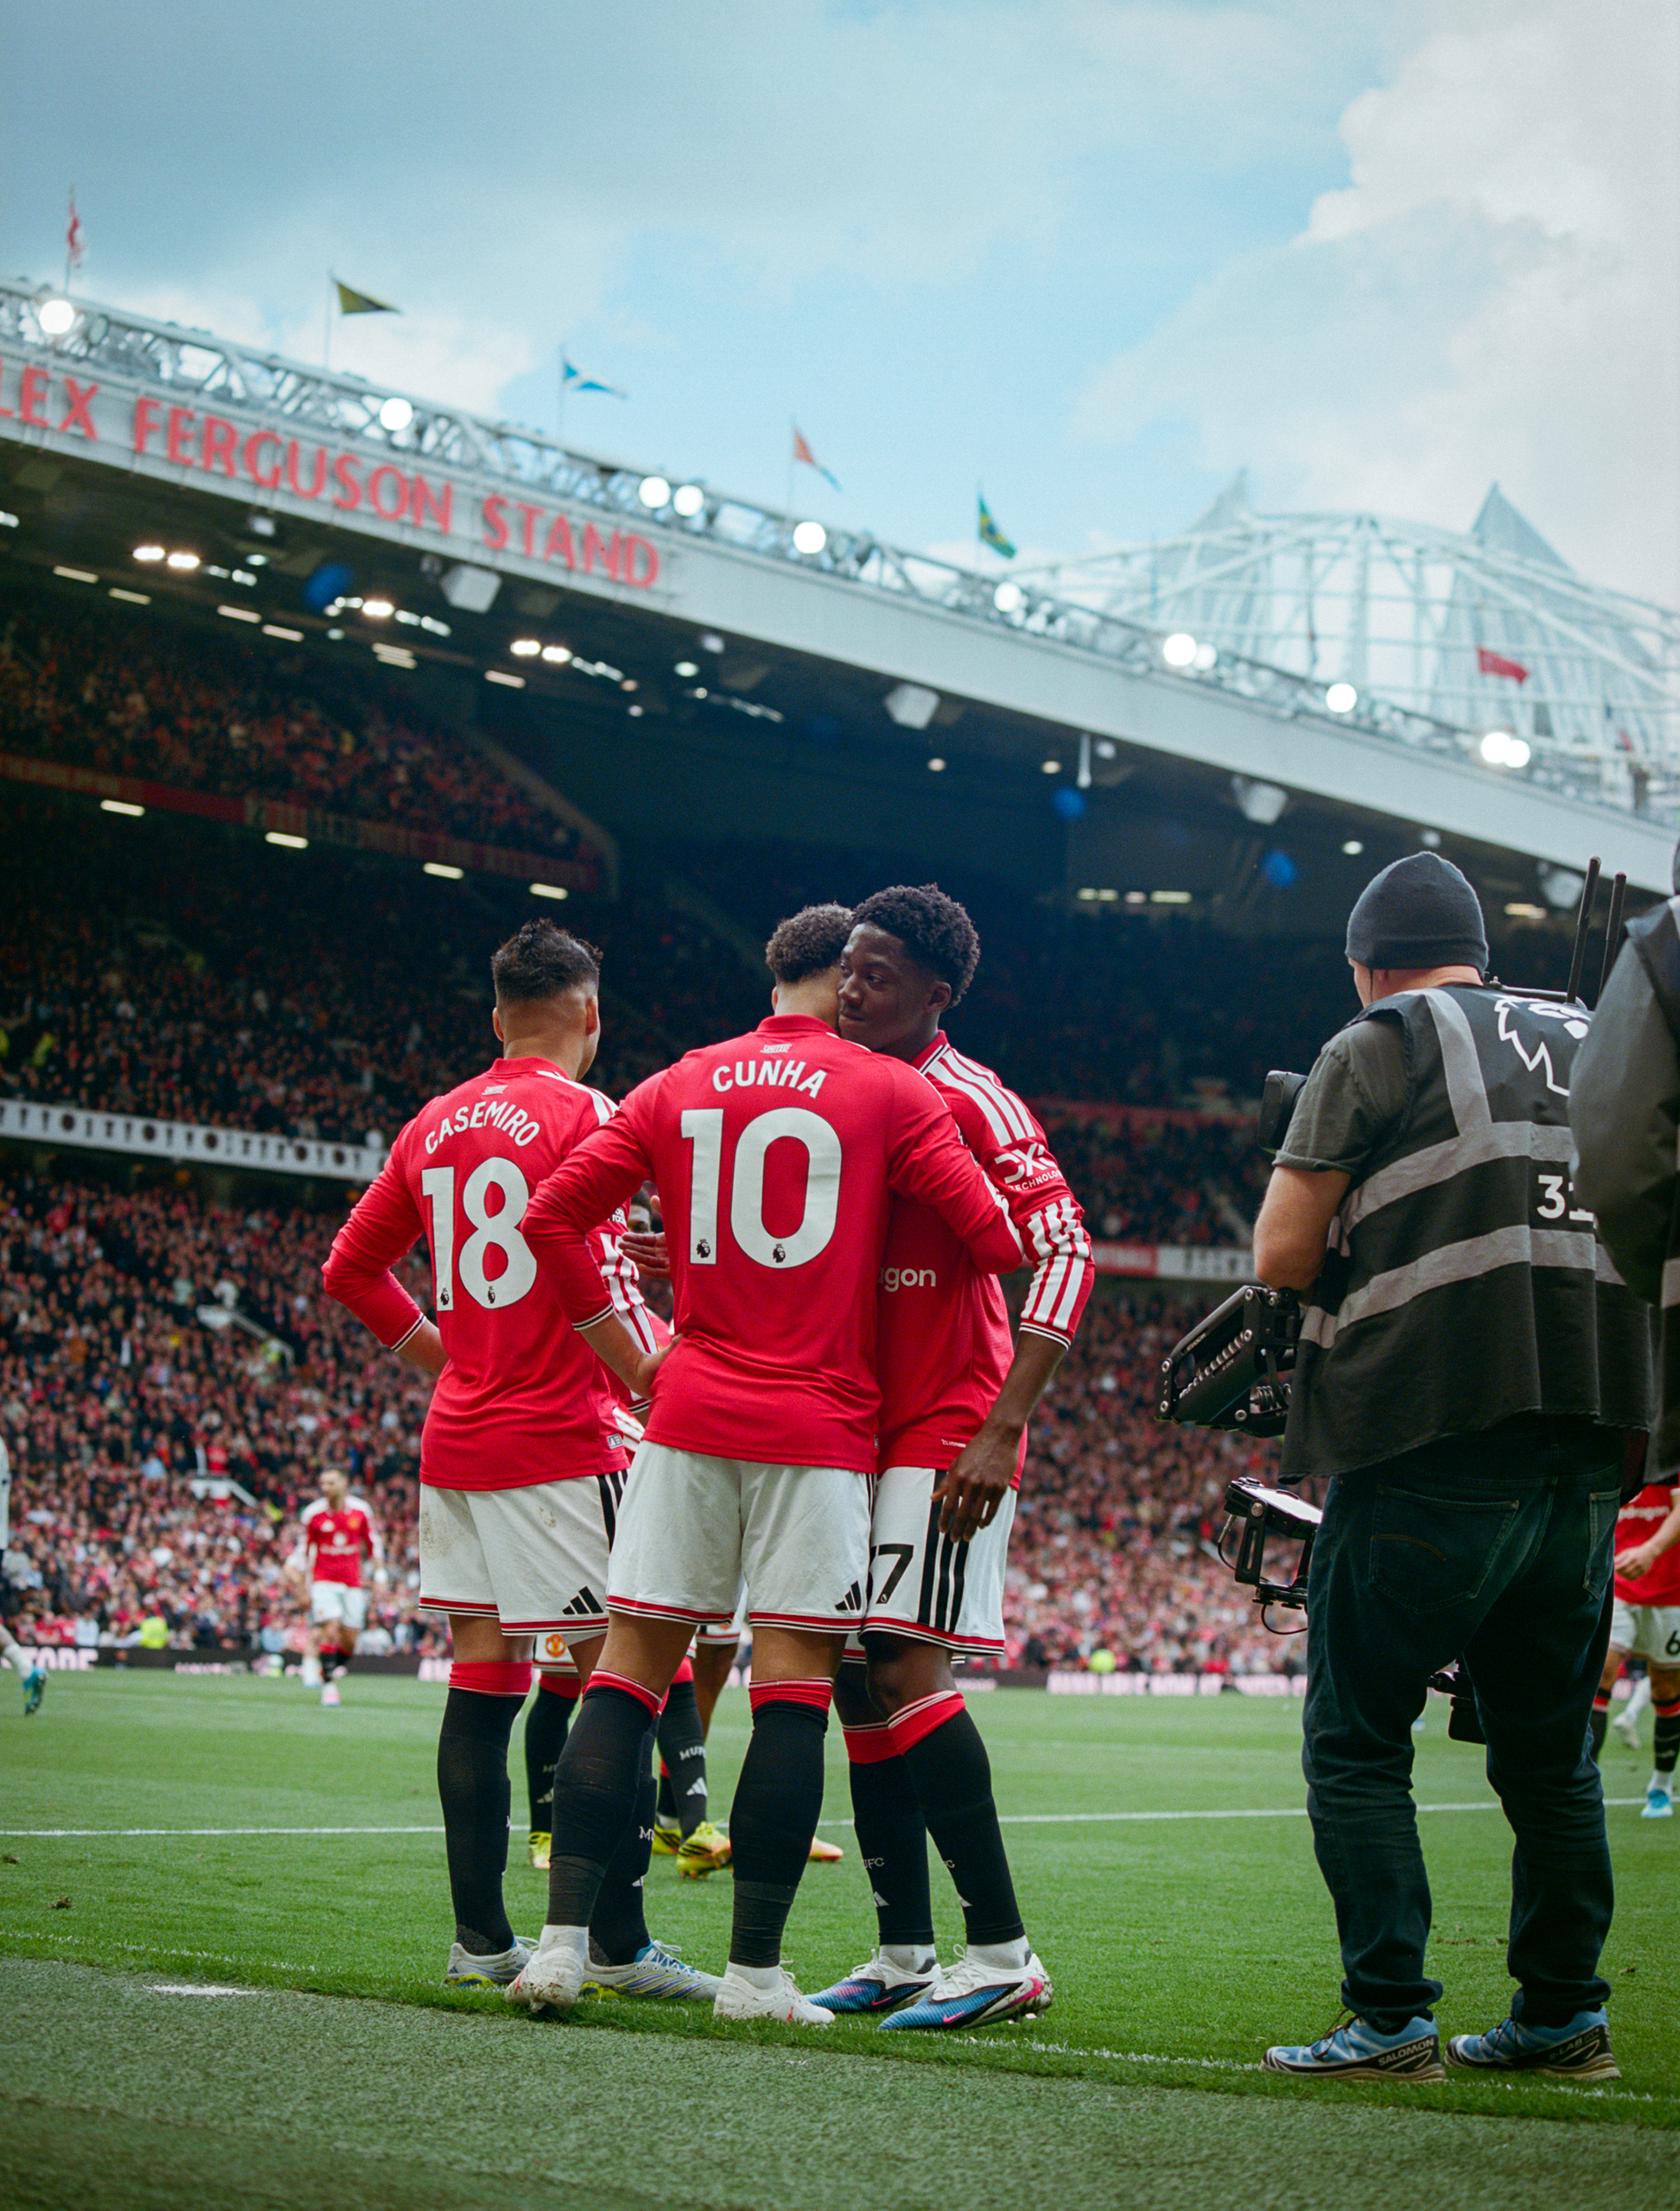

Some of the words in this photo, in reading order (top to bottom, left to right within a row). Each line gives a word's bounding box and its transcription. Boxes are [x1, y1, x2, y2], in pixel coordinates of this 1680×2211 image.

[133, 396, 454, 536] FERGUSON
[481, 494, 661, 590] STAND
[712, 1059, 828, 1099] CUNHA
[424, 1101, 540, 1155] CASEMIRO
[680, 1107, 842, 1269] 10
[421, 1156, 537, 1312] 18
[880, 1266, 937, 1293] gon
[867, 1543, 915, 1605] 7
[1378, 2037, 1436, 2067] SALOMON
